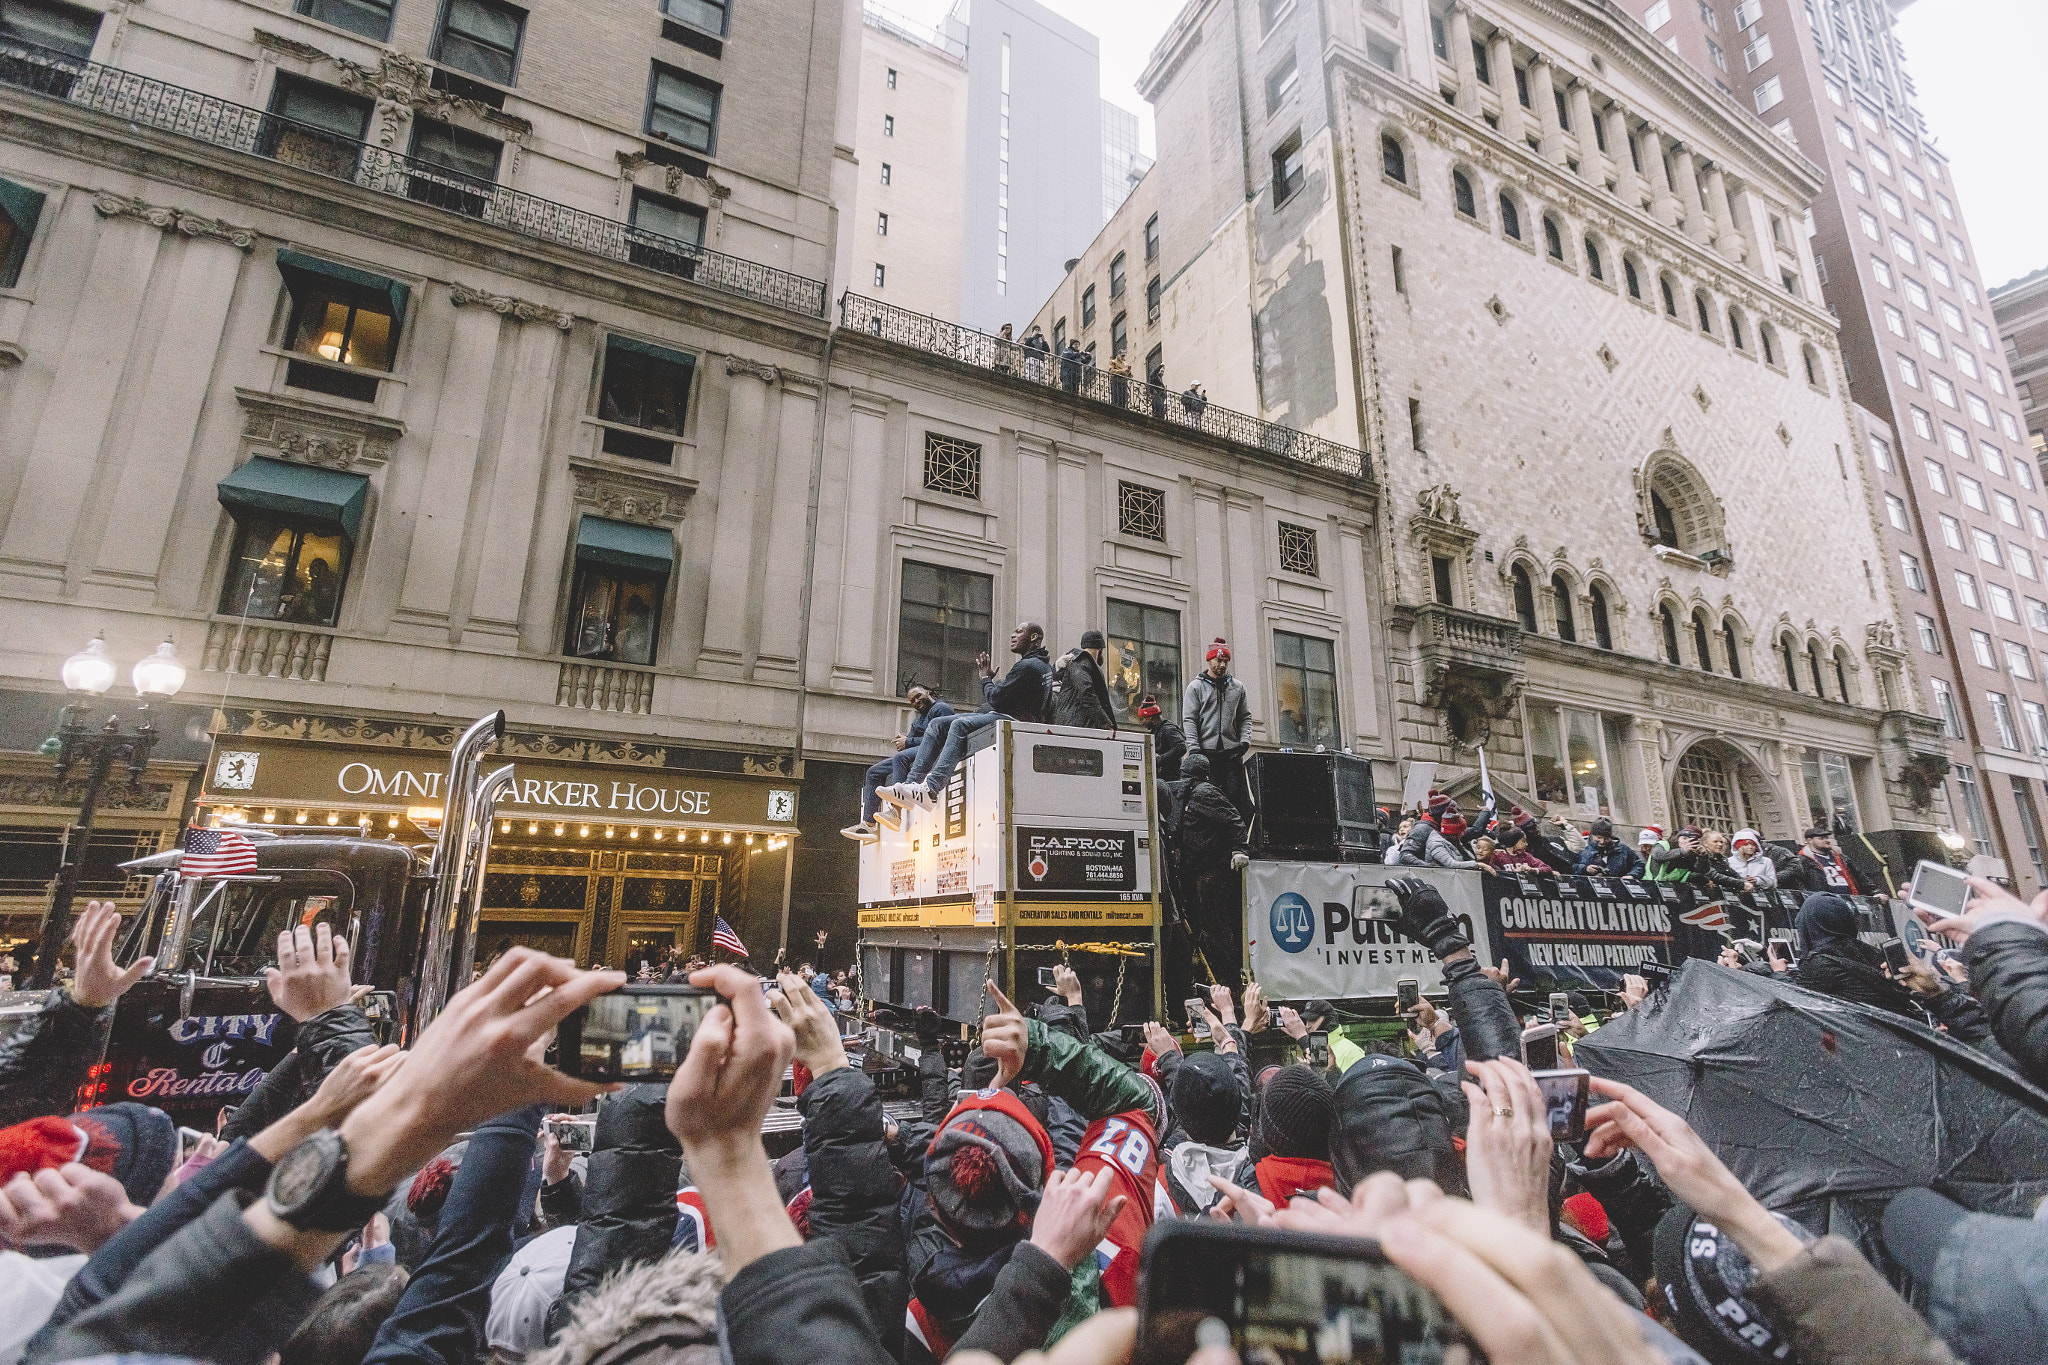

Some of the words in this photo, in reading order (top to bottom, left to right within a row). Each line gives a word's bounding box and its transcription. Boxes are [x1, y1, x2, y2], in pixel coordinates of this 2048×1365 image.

[338, 762, 440, 798] OMNI
[495, 775, 601, 809] ARKER
[609, 781, 711, 815] HOUSE
[1030, 836, 1125, 851] CAPRON
[1120, 893, 1131, 901] 165
[1019, 911, 1051, 919] GENERATOR
[1051, 911, 1068, 919] SALES
[1068, 911, 1081, 919] AND
[1080, 911, 1103, 920] RENTALS
[1323, 902, 1475, 944] Put
[1500, 897, 1672, 933] CONGRATULATIONS
[1325, 950, 1477, 965] INVESTME
[1528, 943, 1555, 966] NEW
[1555, 943, 1604, 966] ENGLAND
[1605, 945, 1658, 967] PATRIOTS
[167, 1013, 282, 1047] CITY
